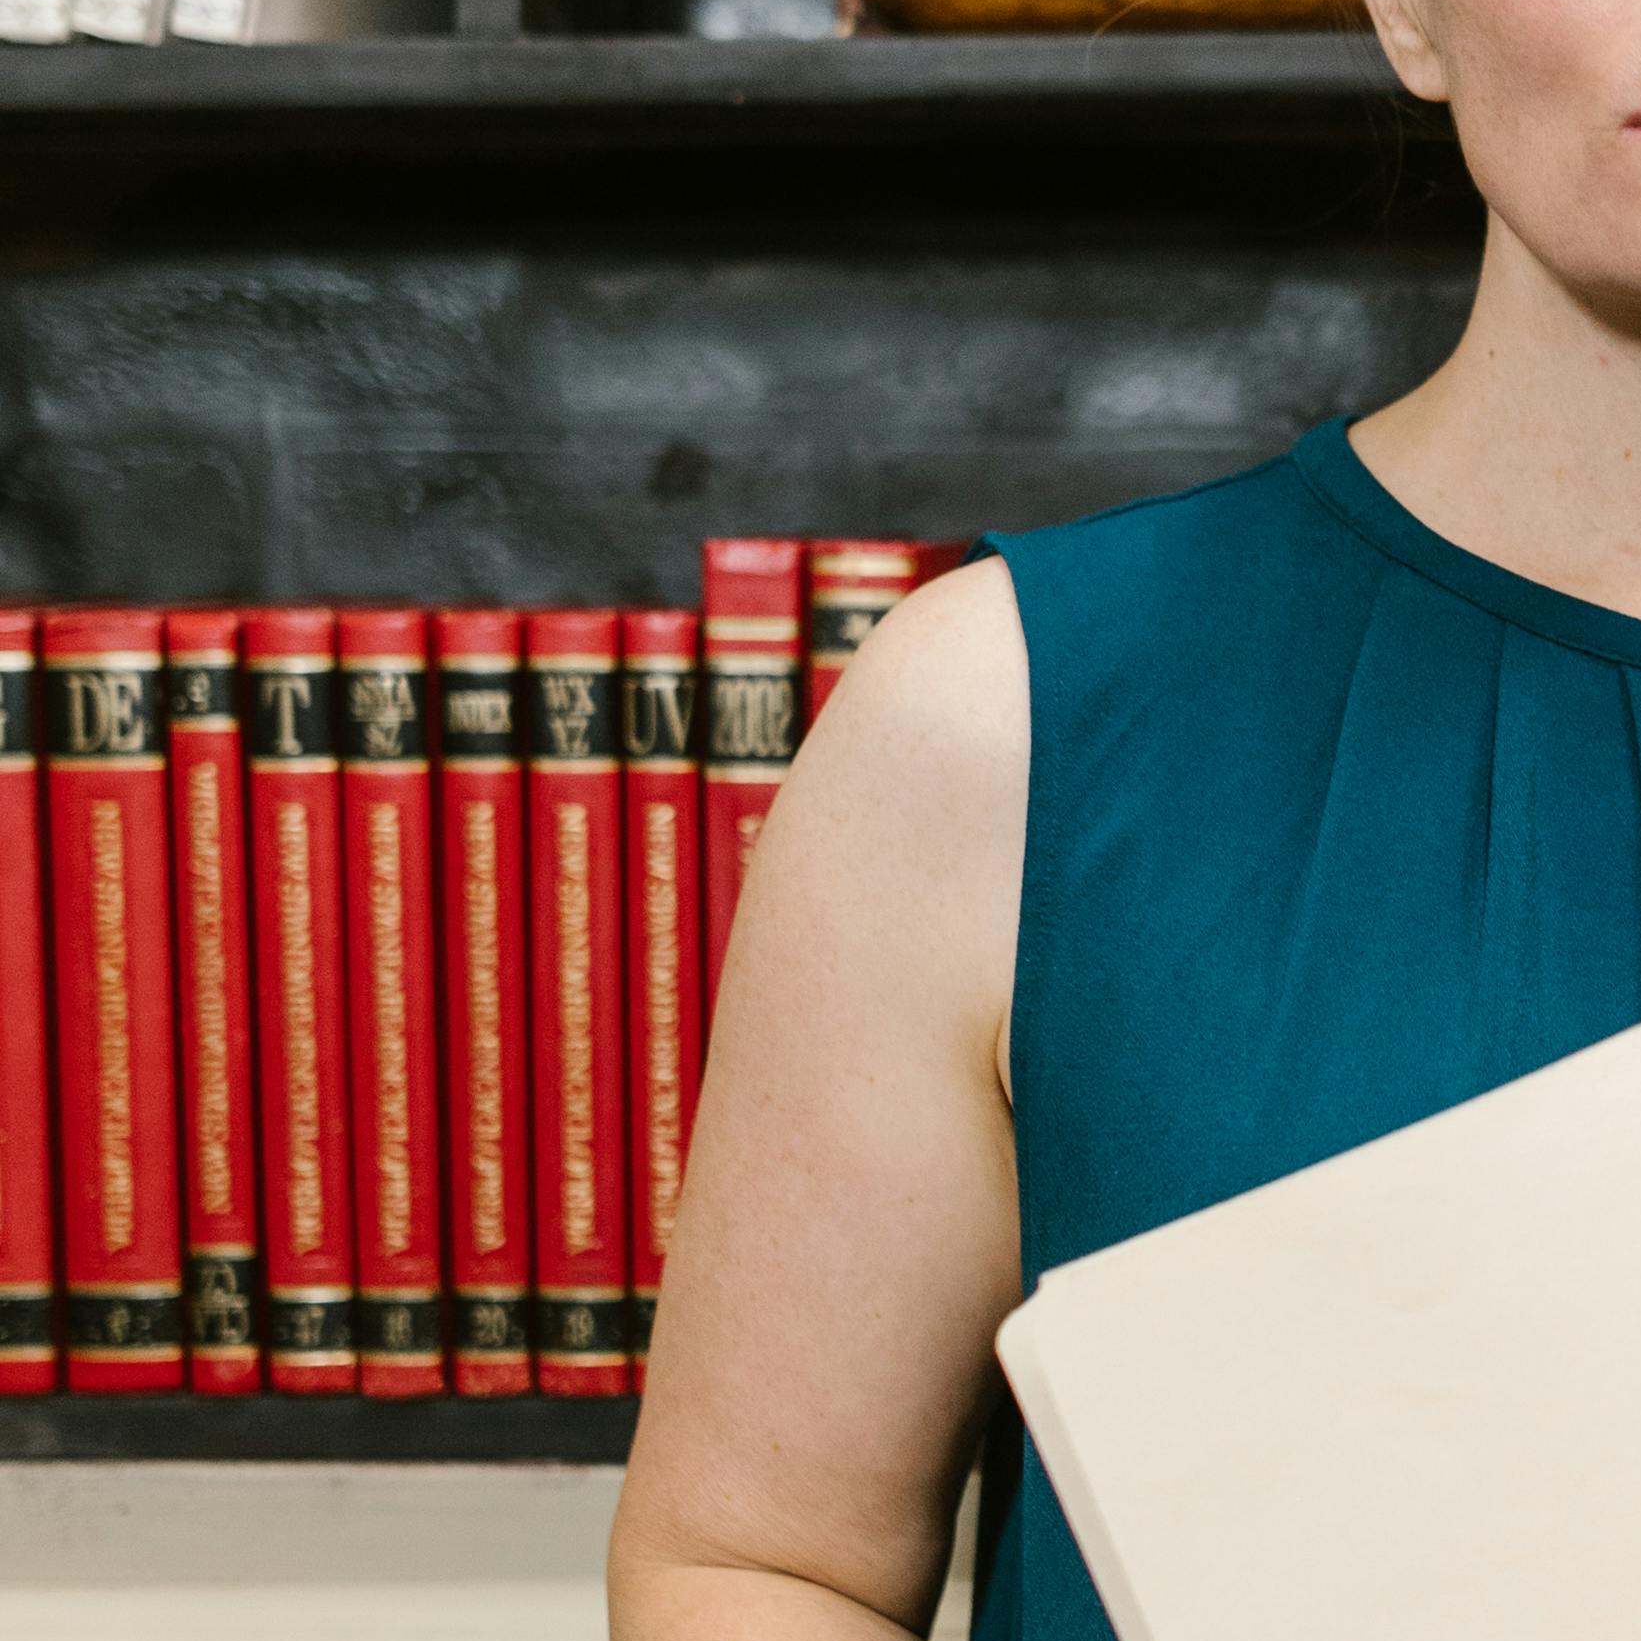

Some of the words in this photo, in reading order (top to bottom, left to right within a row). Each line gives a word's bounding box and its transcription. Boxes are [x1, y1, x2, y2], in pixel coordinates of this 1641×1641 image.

[66, 673, 144, 752] DE
[263, 675, 311, 756] T
[622, 674, 697, 755] UV
